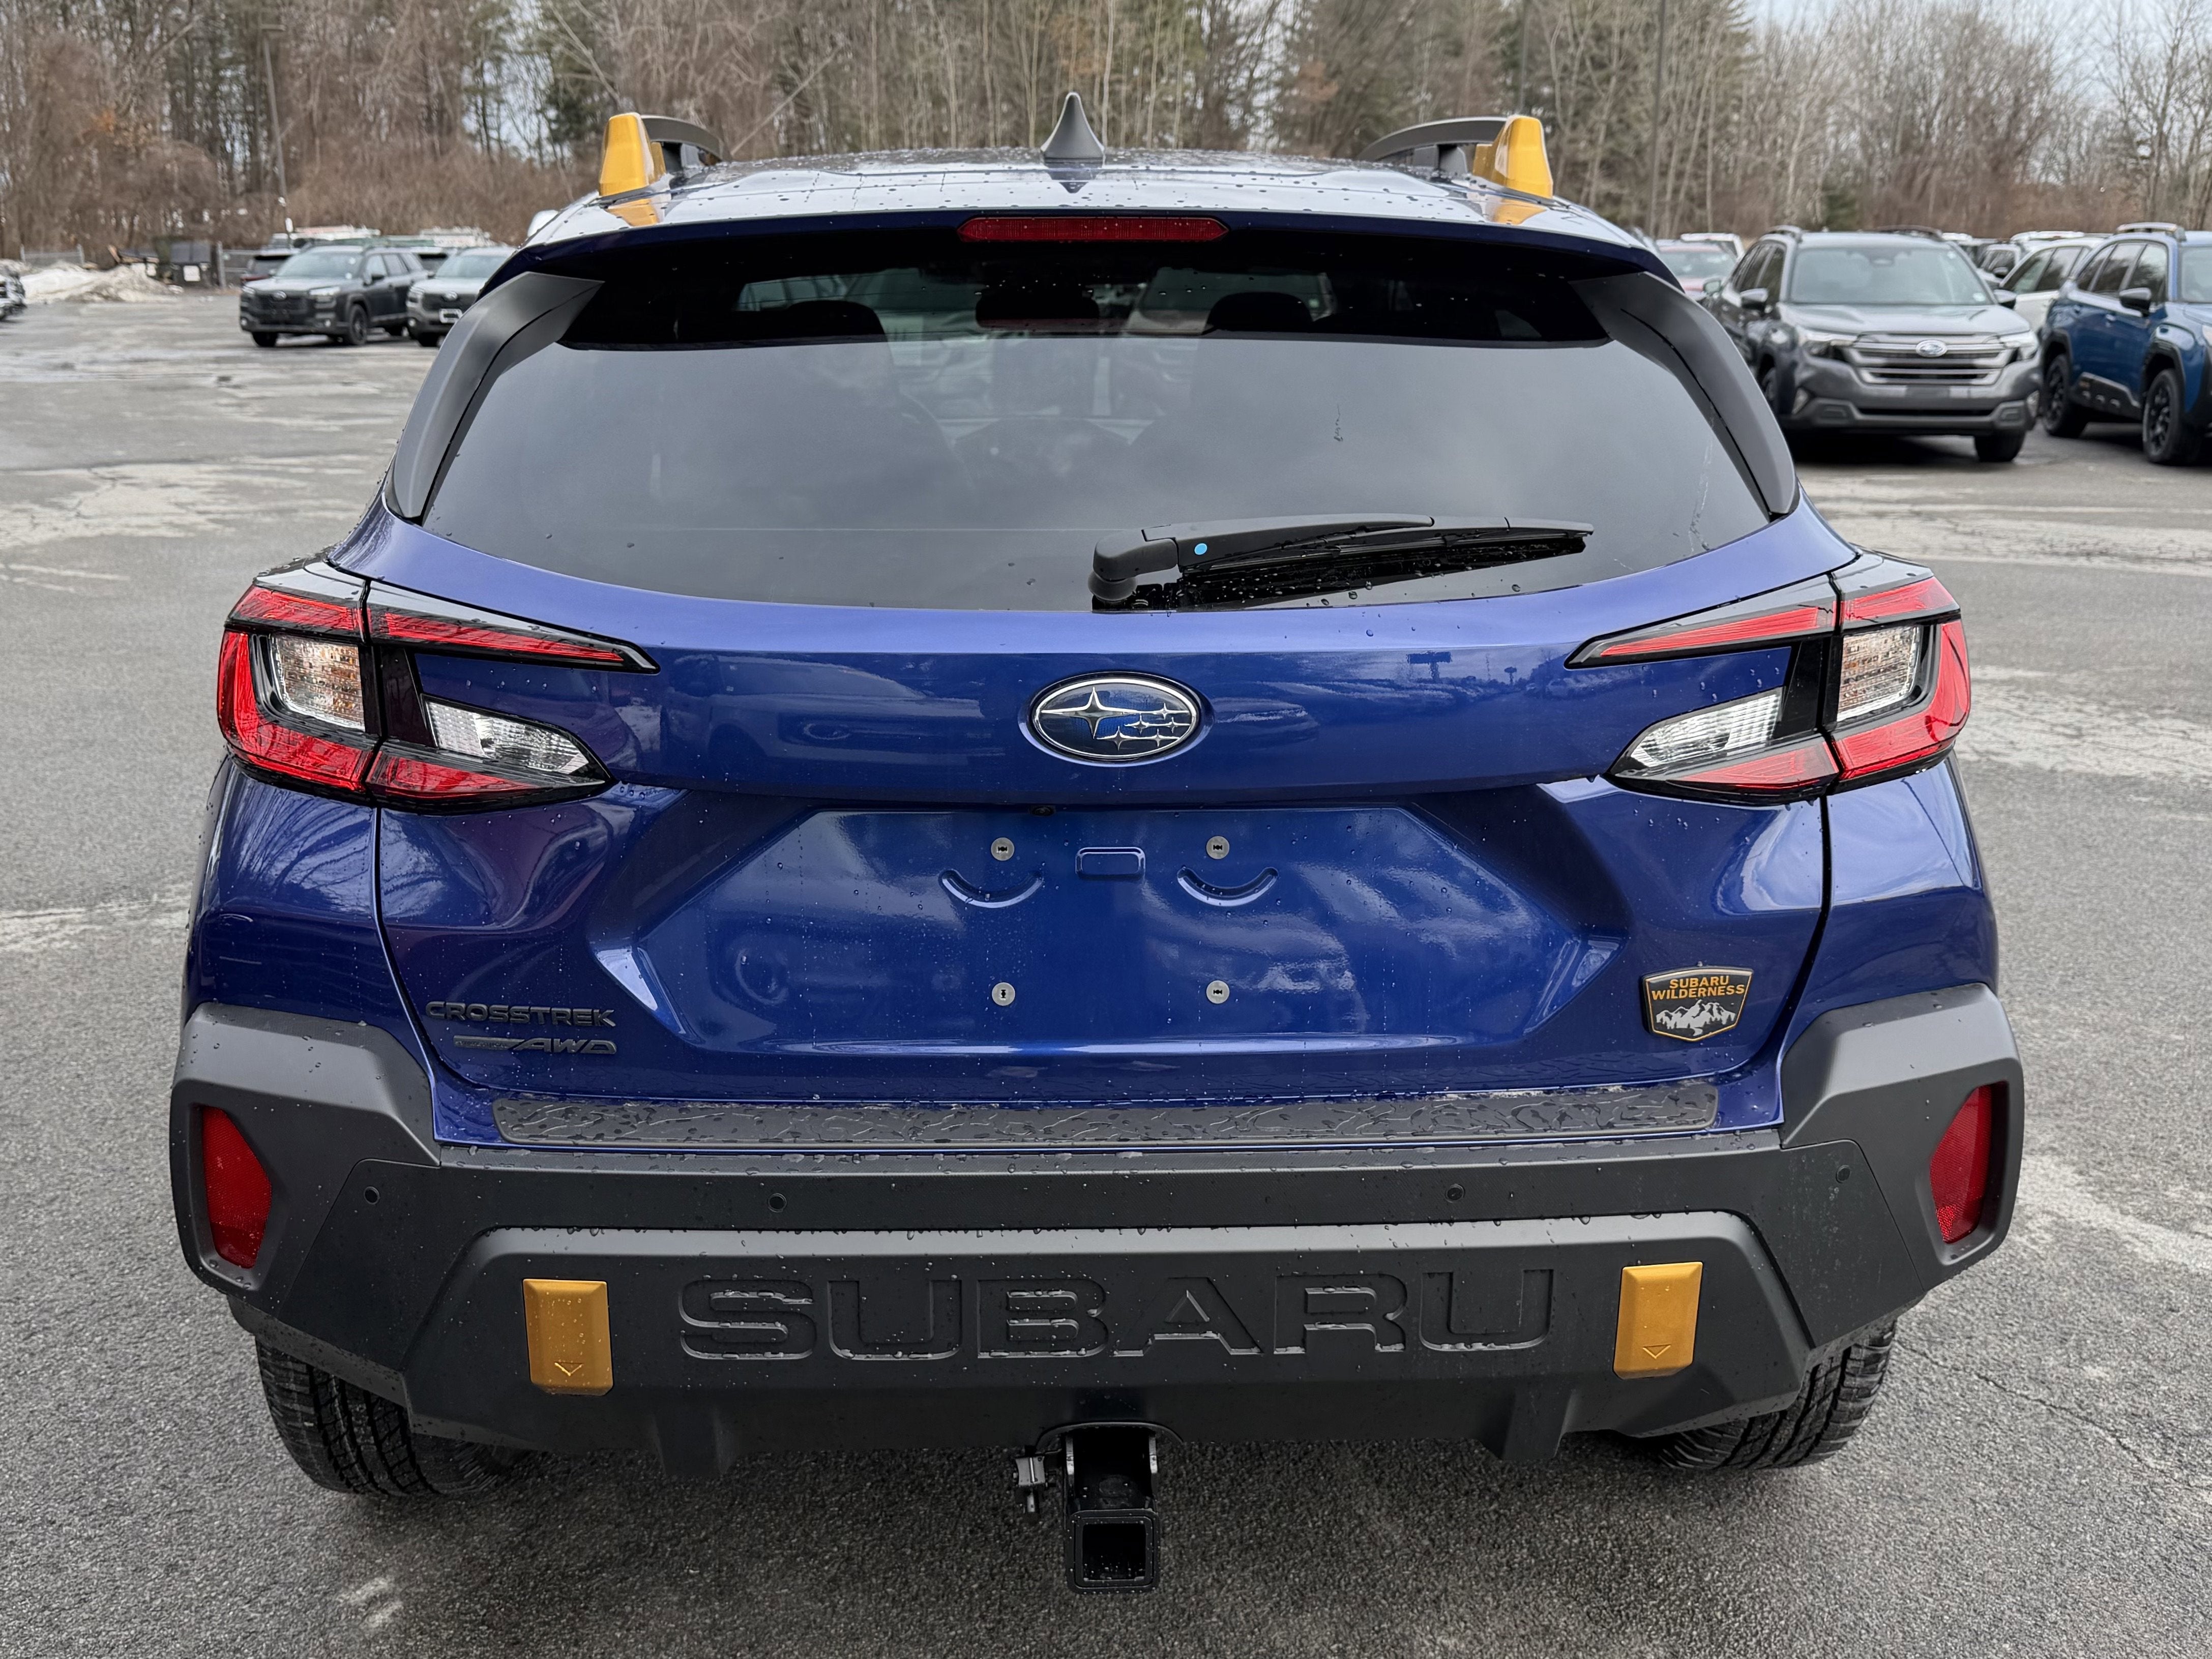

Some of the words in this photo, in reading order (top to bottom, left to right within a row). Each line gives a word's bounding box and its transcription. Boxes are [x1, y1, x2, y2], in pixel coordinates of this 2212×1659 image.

[1669, 975, 1729, 989] SUBARU
[1651, 984, 1745, 1000] WILDERNESS
[426, 1000, 616, 1027] CROSSTREK
[513, 1038, 617, 1055] AWD
[678, 1269, 1554, 1360] SUBARU
